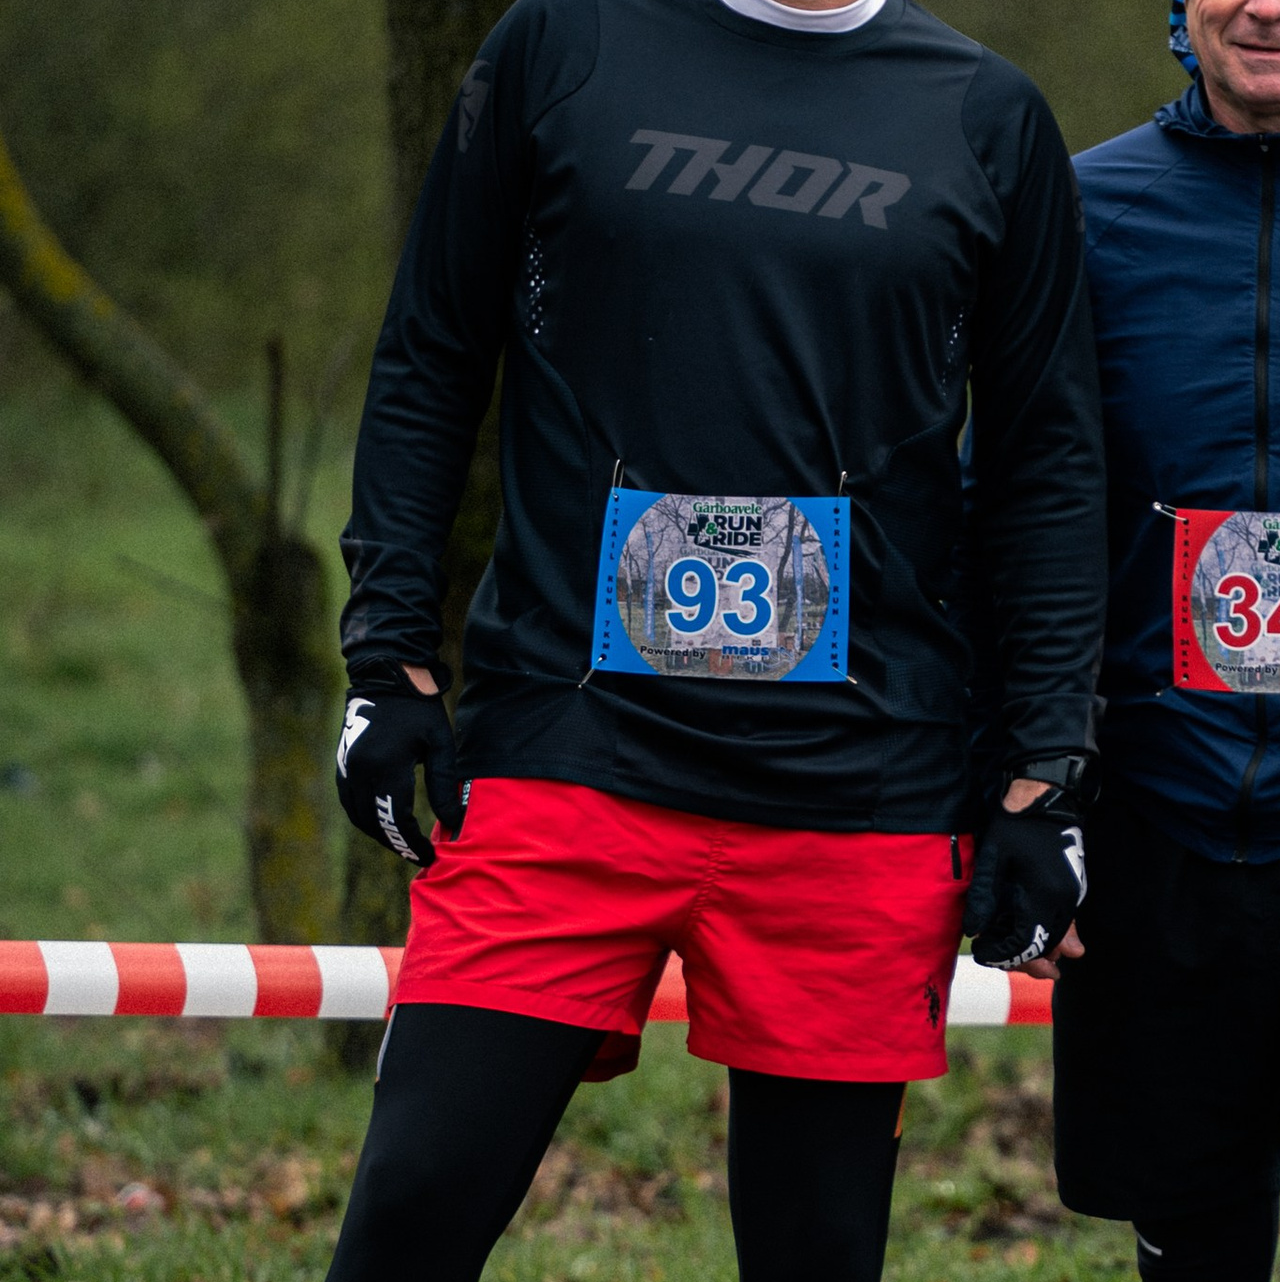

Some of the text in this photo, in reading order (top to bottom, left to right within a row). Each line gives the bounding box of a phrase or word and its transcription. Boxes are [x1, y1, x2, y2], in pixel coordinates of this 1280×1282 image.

[624, 129, 912, 230] THOR
[714, 515, 762, 531] RUN
[610, 508, 619, 561] TRAIL
[713, 532, 761, 546] RIDE
[605, 576, 614, 605] RUN
[666, 558, 774, 636] 93
[640, 646, 706, 660] Powered by
[722, 645, 769, 656] maus
[1215, 662, 1279, 676] Powered by
[375, 794, 420, 861] THOR
